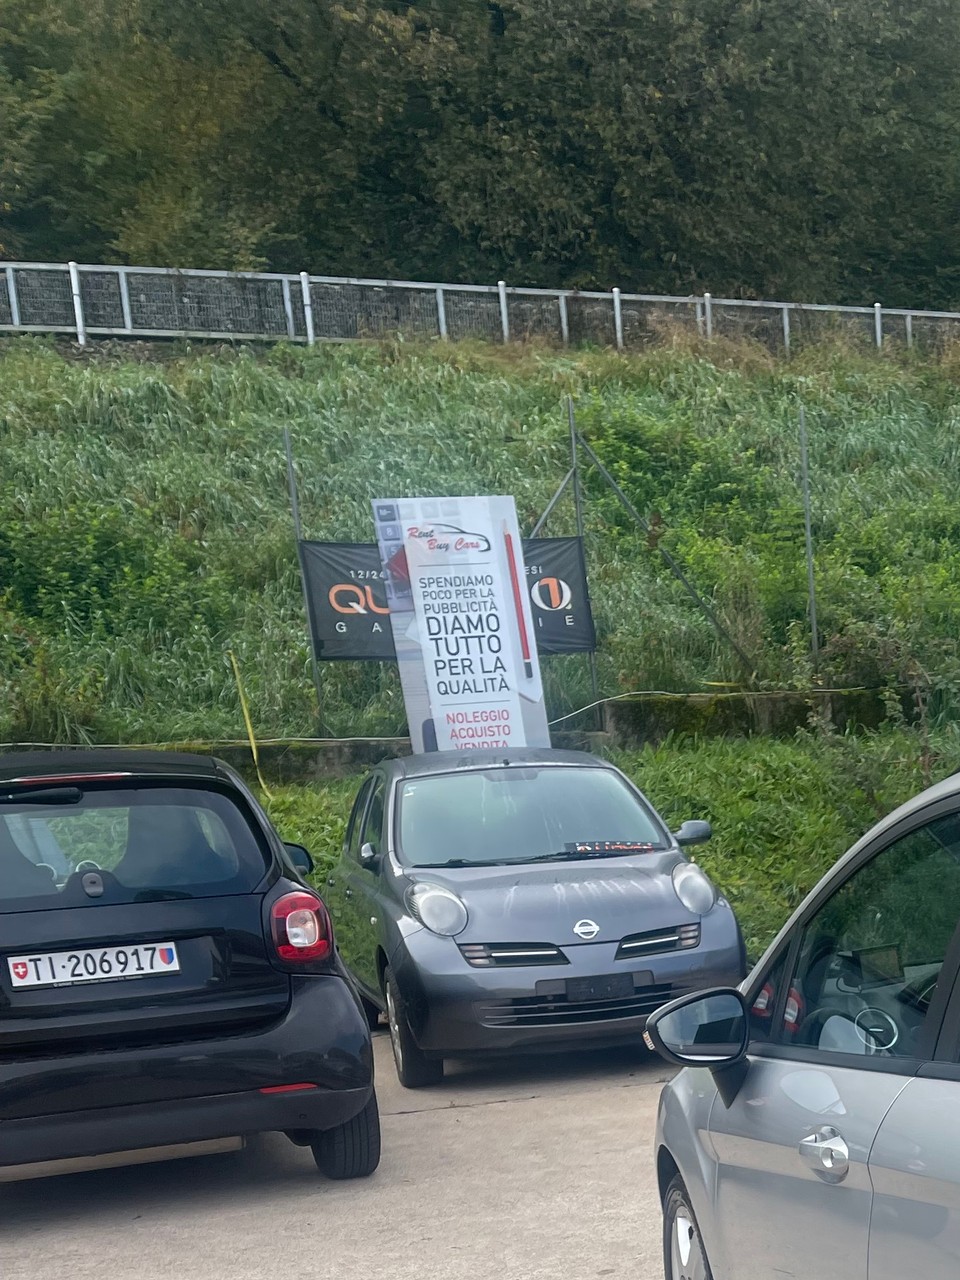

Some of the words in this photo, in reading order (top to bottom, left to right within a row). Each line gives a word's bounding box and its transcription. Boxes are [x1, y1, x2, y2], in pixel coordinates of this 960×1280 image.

[407, 527, 434, 539] Rent
[427, 538, 450, 551] Buy
[454, 537, 480, 551] Cars
[524, 566, 543, 575] ESI
[418, 574, 494, 589] SPENDIAMO
[422, 589, 452, 600] POCO
[455, 588, 477, 599] PER
[479, 588, 495, 598] LA
[423, 598, 498, 615] PUBBLICITÀ
[426, 613, 501, 636] DIAMO
[429, 634, 502, 657] TUTTO
[434, 657, 475, 677] PER
[479, 656, 507, 674] LA
[436, 673, 510, 695] QUALITÀ
[445, 709, 510, 725] NOLEGGIO
[450, 724, 511, 740] ACQUISTO
